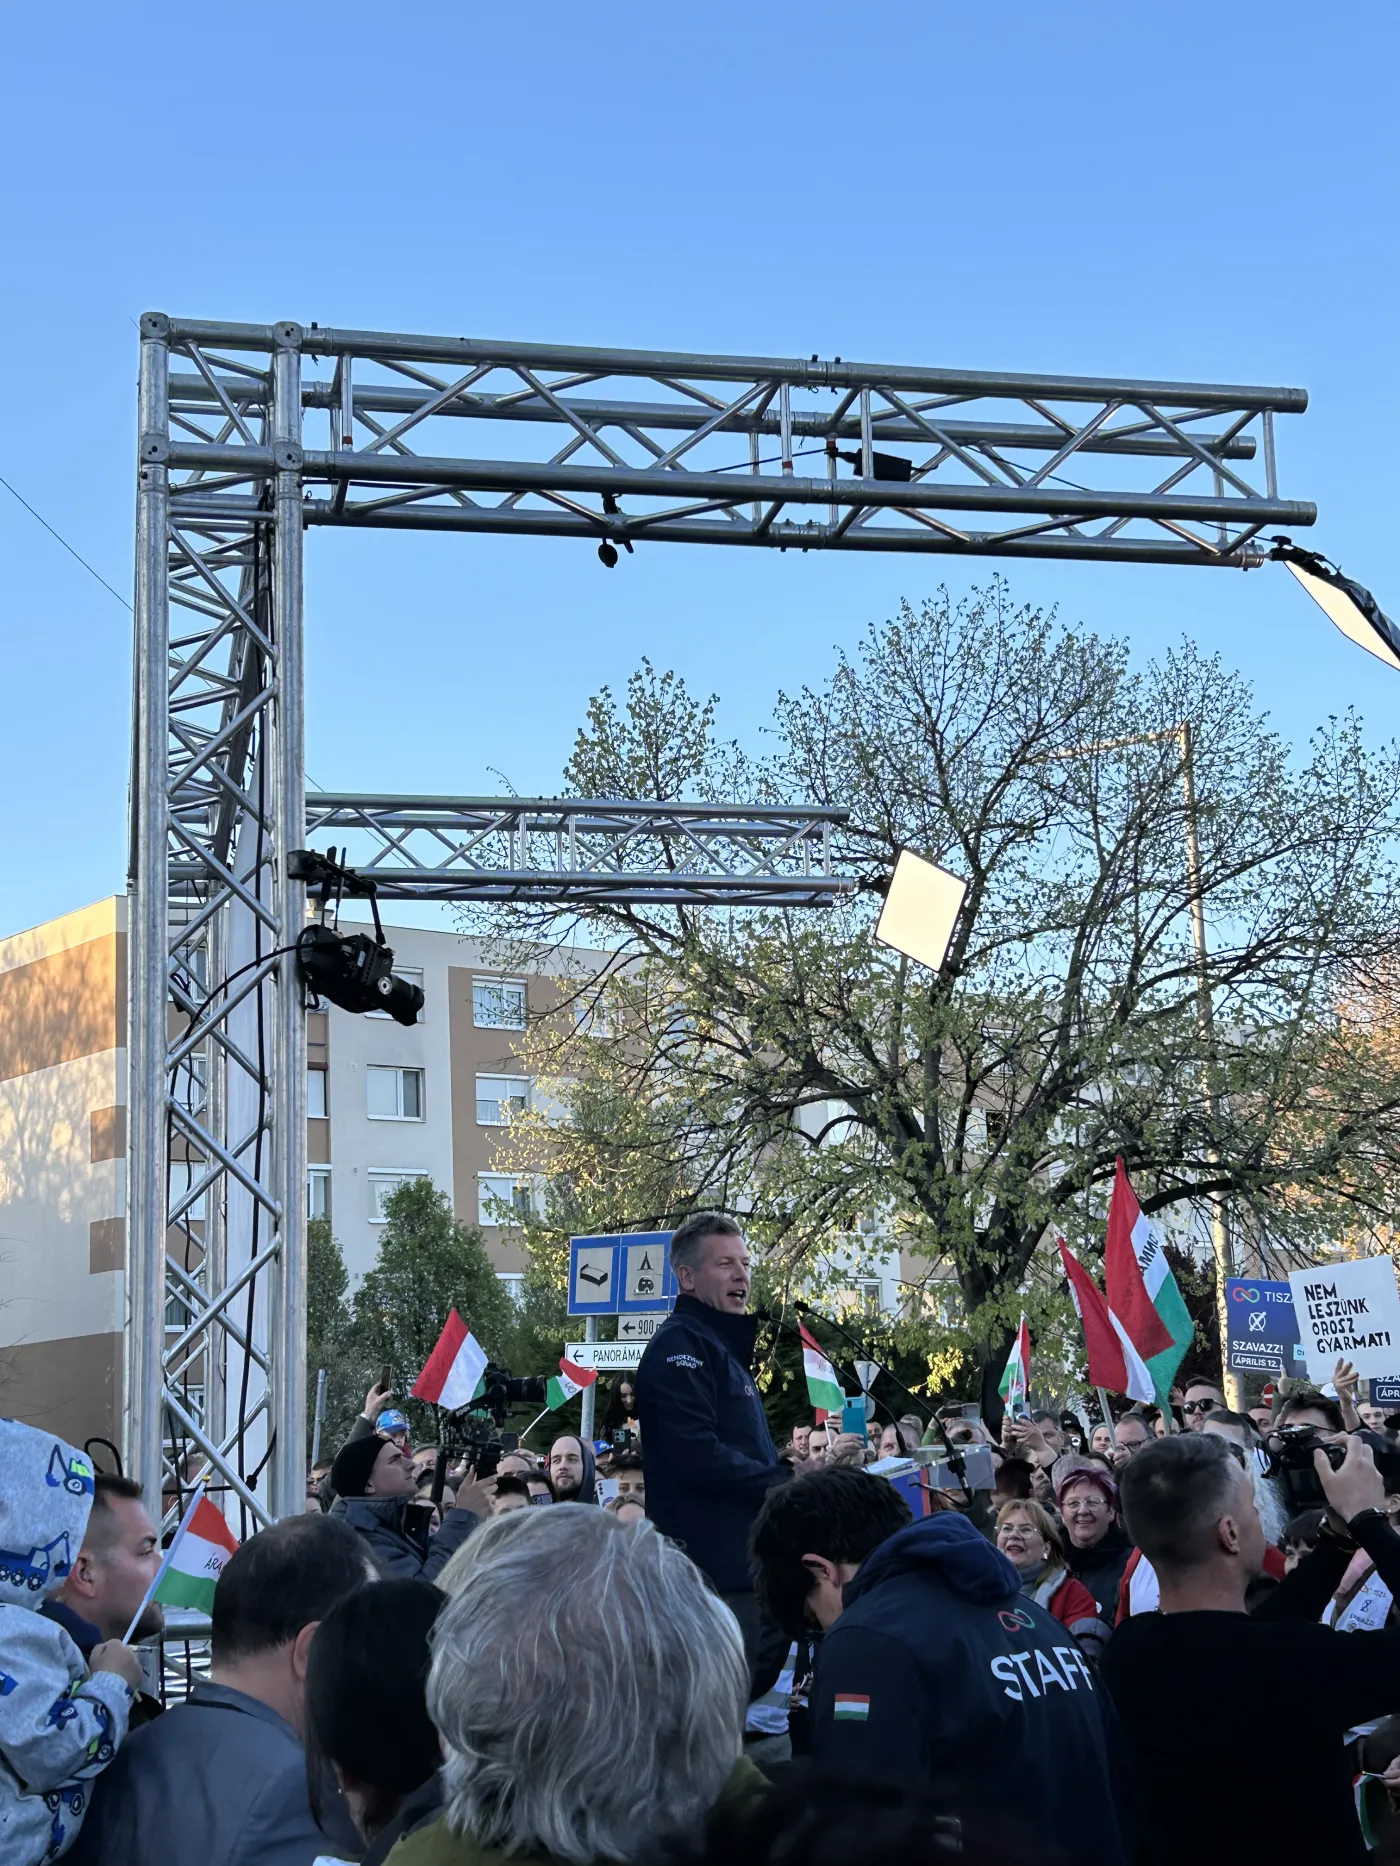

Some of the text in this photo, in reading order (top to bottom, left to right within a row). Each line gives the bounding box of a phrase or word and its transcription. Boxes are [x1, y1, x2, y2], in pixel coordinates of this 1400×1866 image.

[1264, 1291, 1293, 1304] TISZ
[1304, 1282, 1338, 1302] NEM
[638, 1319, 654, 1335] 900
[1312, 1317, 1355, 1336] OROSZ
[593, 1346, 642, 1362] PANORÁMA
[1232, 1340, 1284, 1355] SZAVAZZ!
[1235, 1354, 1267, 1367] ÁPRILIS
[990, 1646, 1093, 1701] STAFF
